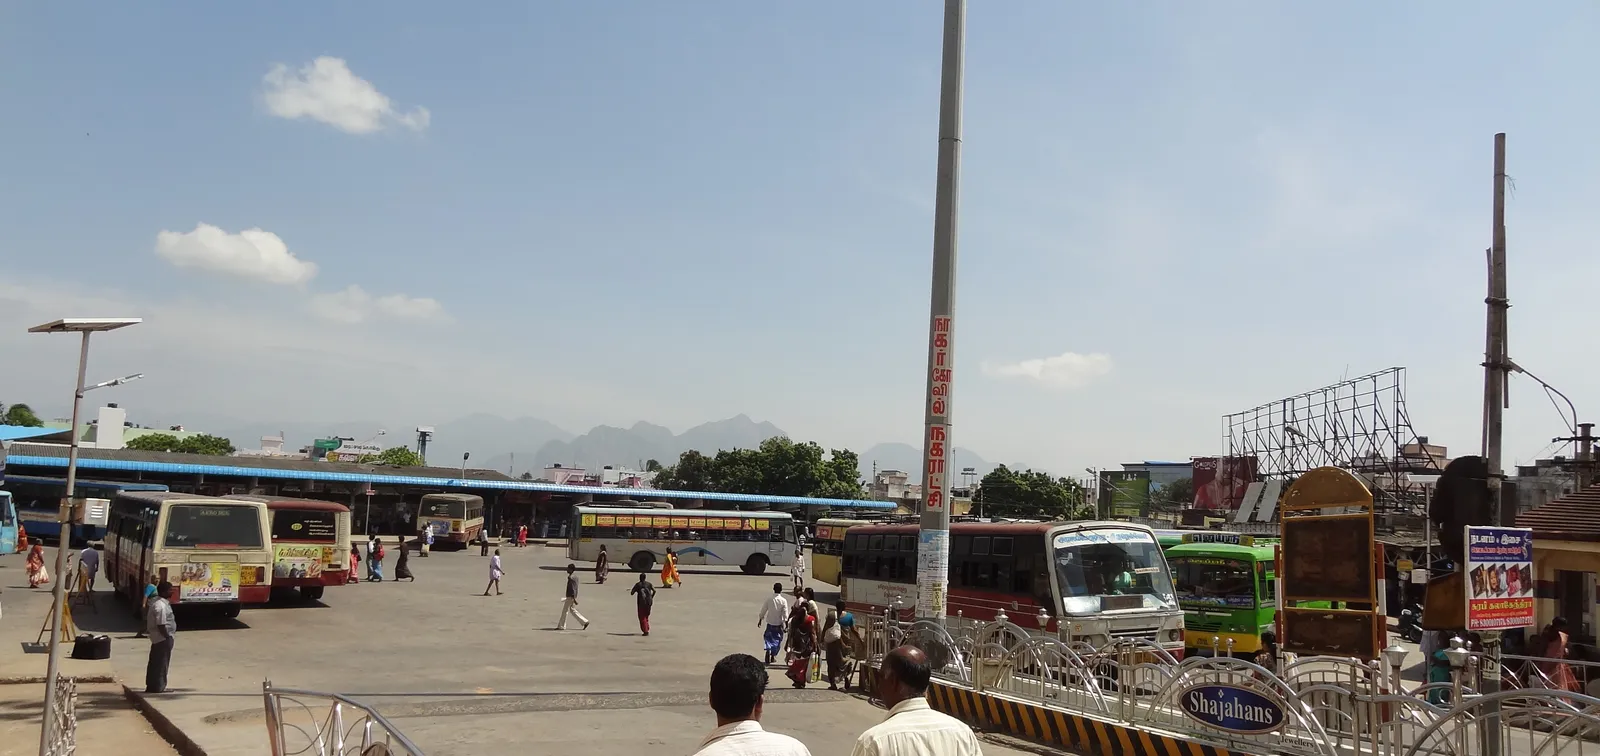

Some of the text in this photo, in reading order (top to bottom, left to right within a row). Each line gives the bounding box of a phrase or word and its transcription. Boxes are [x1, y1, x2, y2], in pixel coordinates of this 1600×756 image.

[932, 317, 952, 416] நாகர்கோவில்
[927, 426, 946, 508] நகராட்சி
[1500, 534, 1521, 545] இசை
[1190, 689, 1273, 724] Shajahans
[1280, 735, 1314, 748] Jewellers
